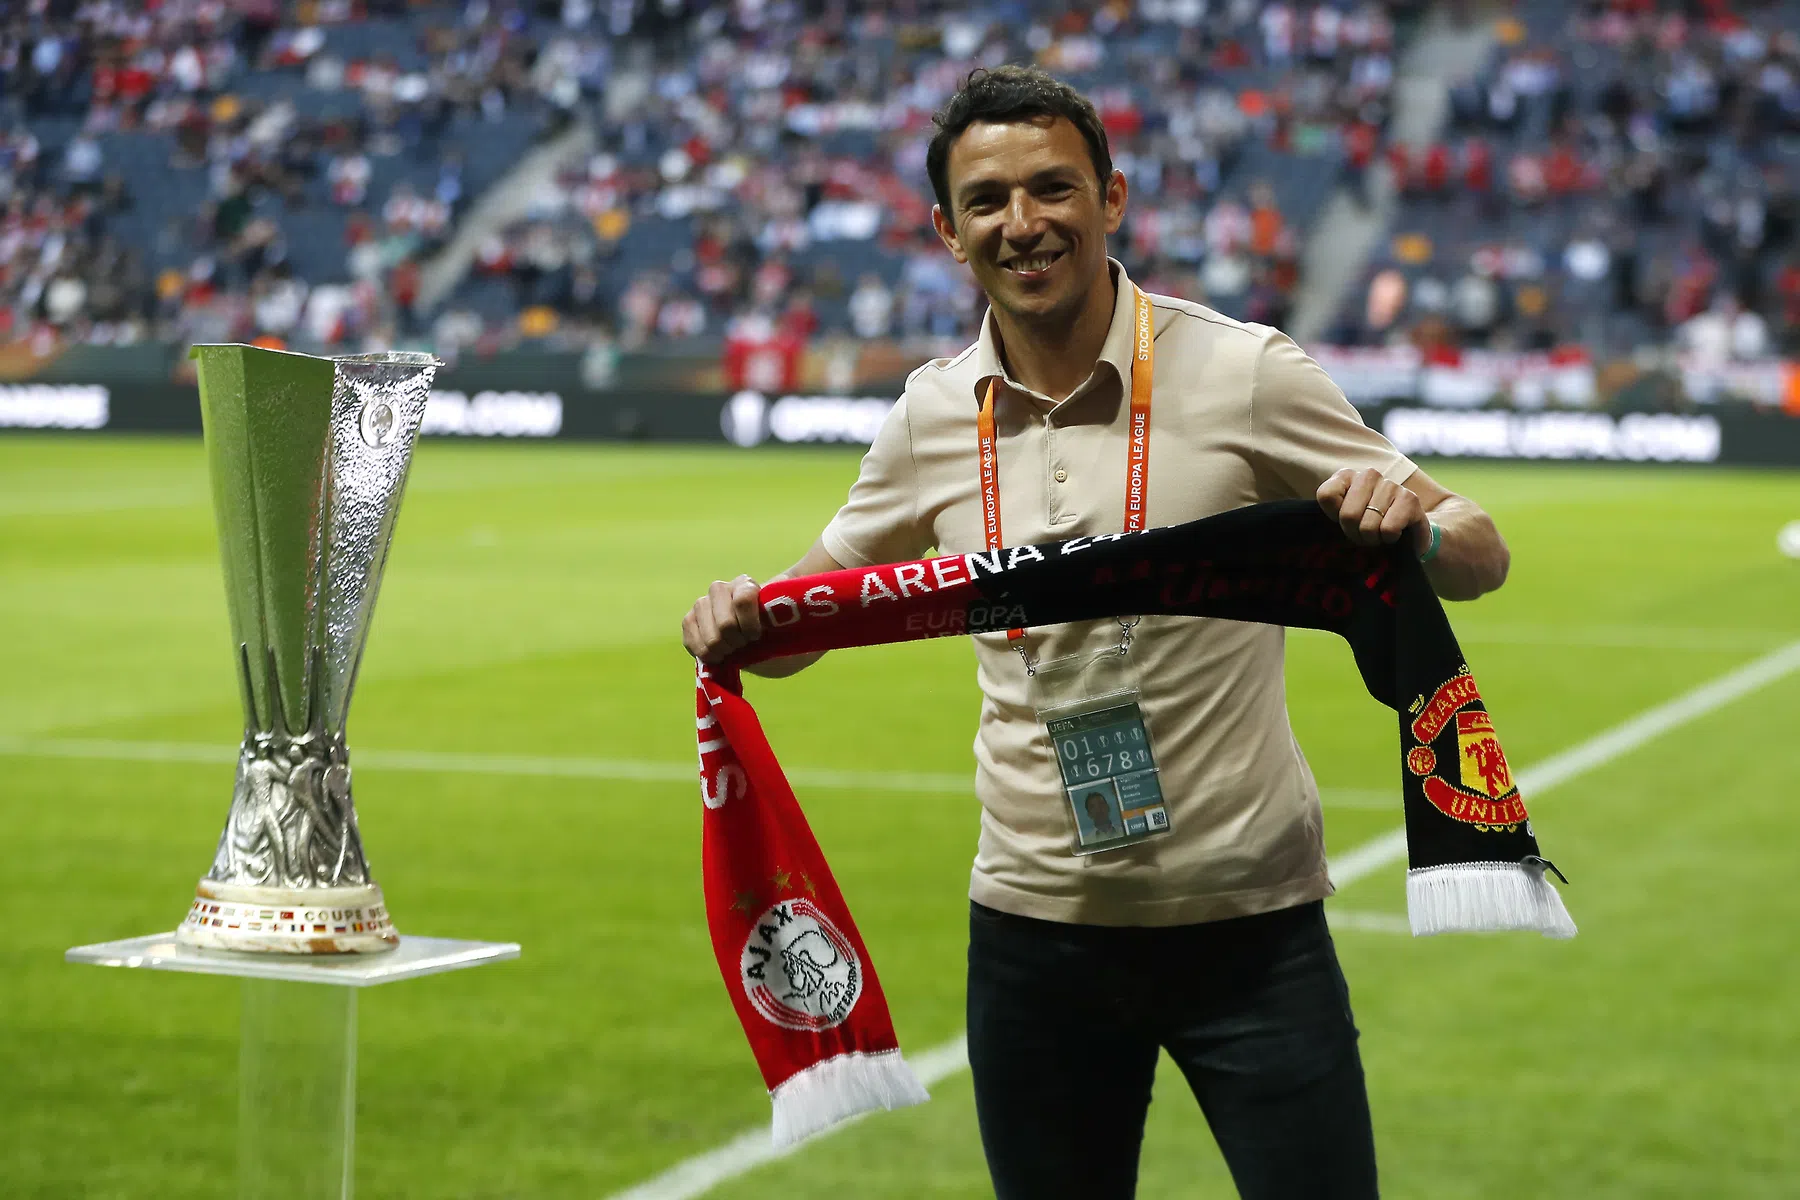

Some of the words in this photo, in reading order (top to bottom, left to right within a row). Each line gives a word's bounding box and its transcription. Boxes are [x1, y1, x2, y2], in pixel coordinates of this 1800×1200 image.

[1139, 297, 1149, 361] STOCKHOLM
[982, 436, 993, 484] LEAGUE
[1133, 413, 1145, 460] LEAGUE
[985, 485, 996, 533] EUROPA
[1130, 463, 1143, 511] EUROPA
[763, 584, 840, 628] DS
[860, 544, 1045, 609] ARENA
[905, 603, 1029, 632] EUROPA
[1050, 720, 1075, 733] UEFA
[1063, 736, 1094, 761] 01
[1420, 678, 1478, 734] MANC
[1450, 795, 1526, 821] UNITE
[1086, 751, 1133, 777] 678
[304, 909, 363, 921] COUPE
[746, 904, 794, 981] AJAX
